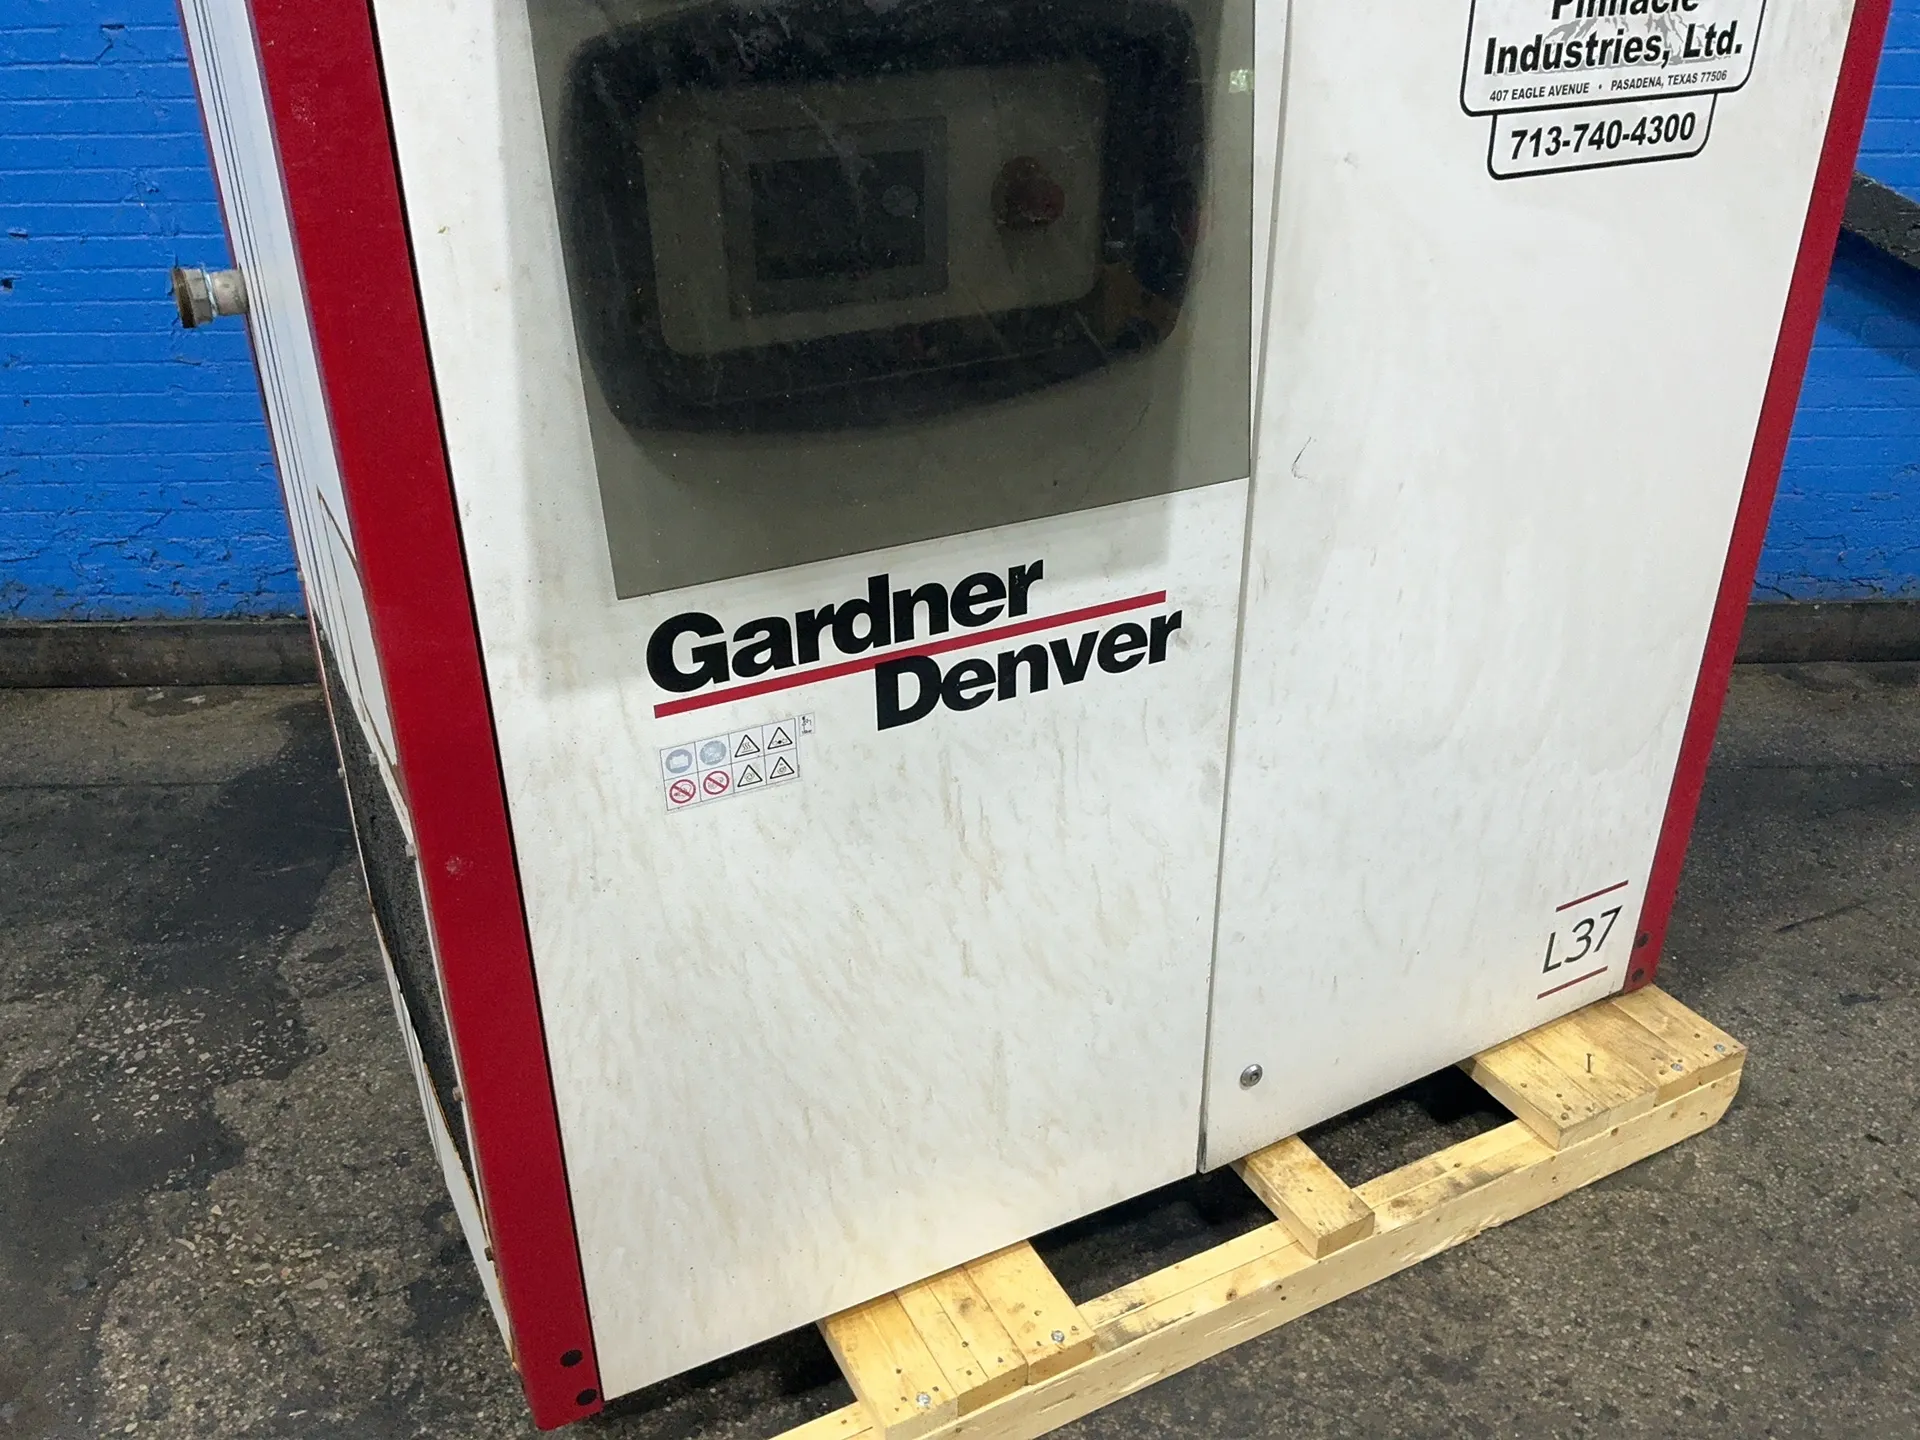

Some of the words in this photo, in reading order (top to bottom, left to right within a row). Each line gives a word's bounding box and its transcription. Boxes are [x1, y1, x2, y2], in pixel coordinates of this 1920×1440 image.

[1485, 28, 1670, 75] Industries,
[1683, 20, 1742, 59] Ltd.
[1489, 89, 1509, 102] 407
[1511, 86, 1546, 101] EAGLE
[1548, 82, 1590, 97] AVENUE
[1610, 75, 1664, 91] PASADENA,
[1667, 73, 1698, 86] TEXAS
[1700, 69, 1728, 83] 77506
[1510, 112, 1697, 160] 713-740-4300
[646, 559, 1044, 693] Gardner
[874, 609, 1183, 731] Denver
[1542, 904, 1623, 974] L37
